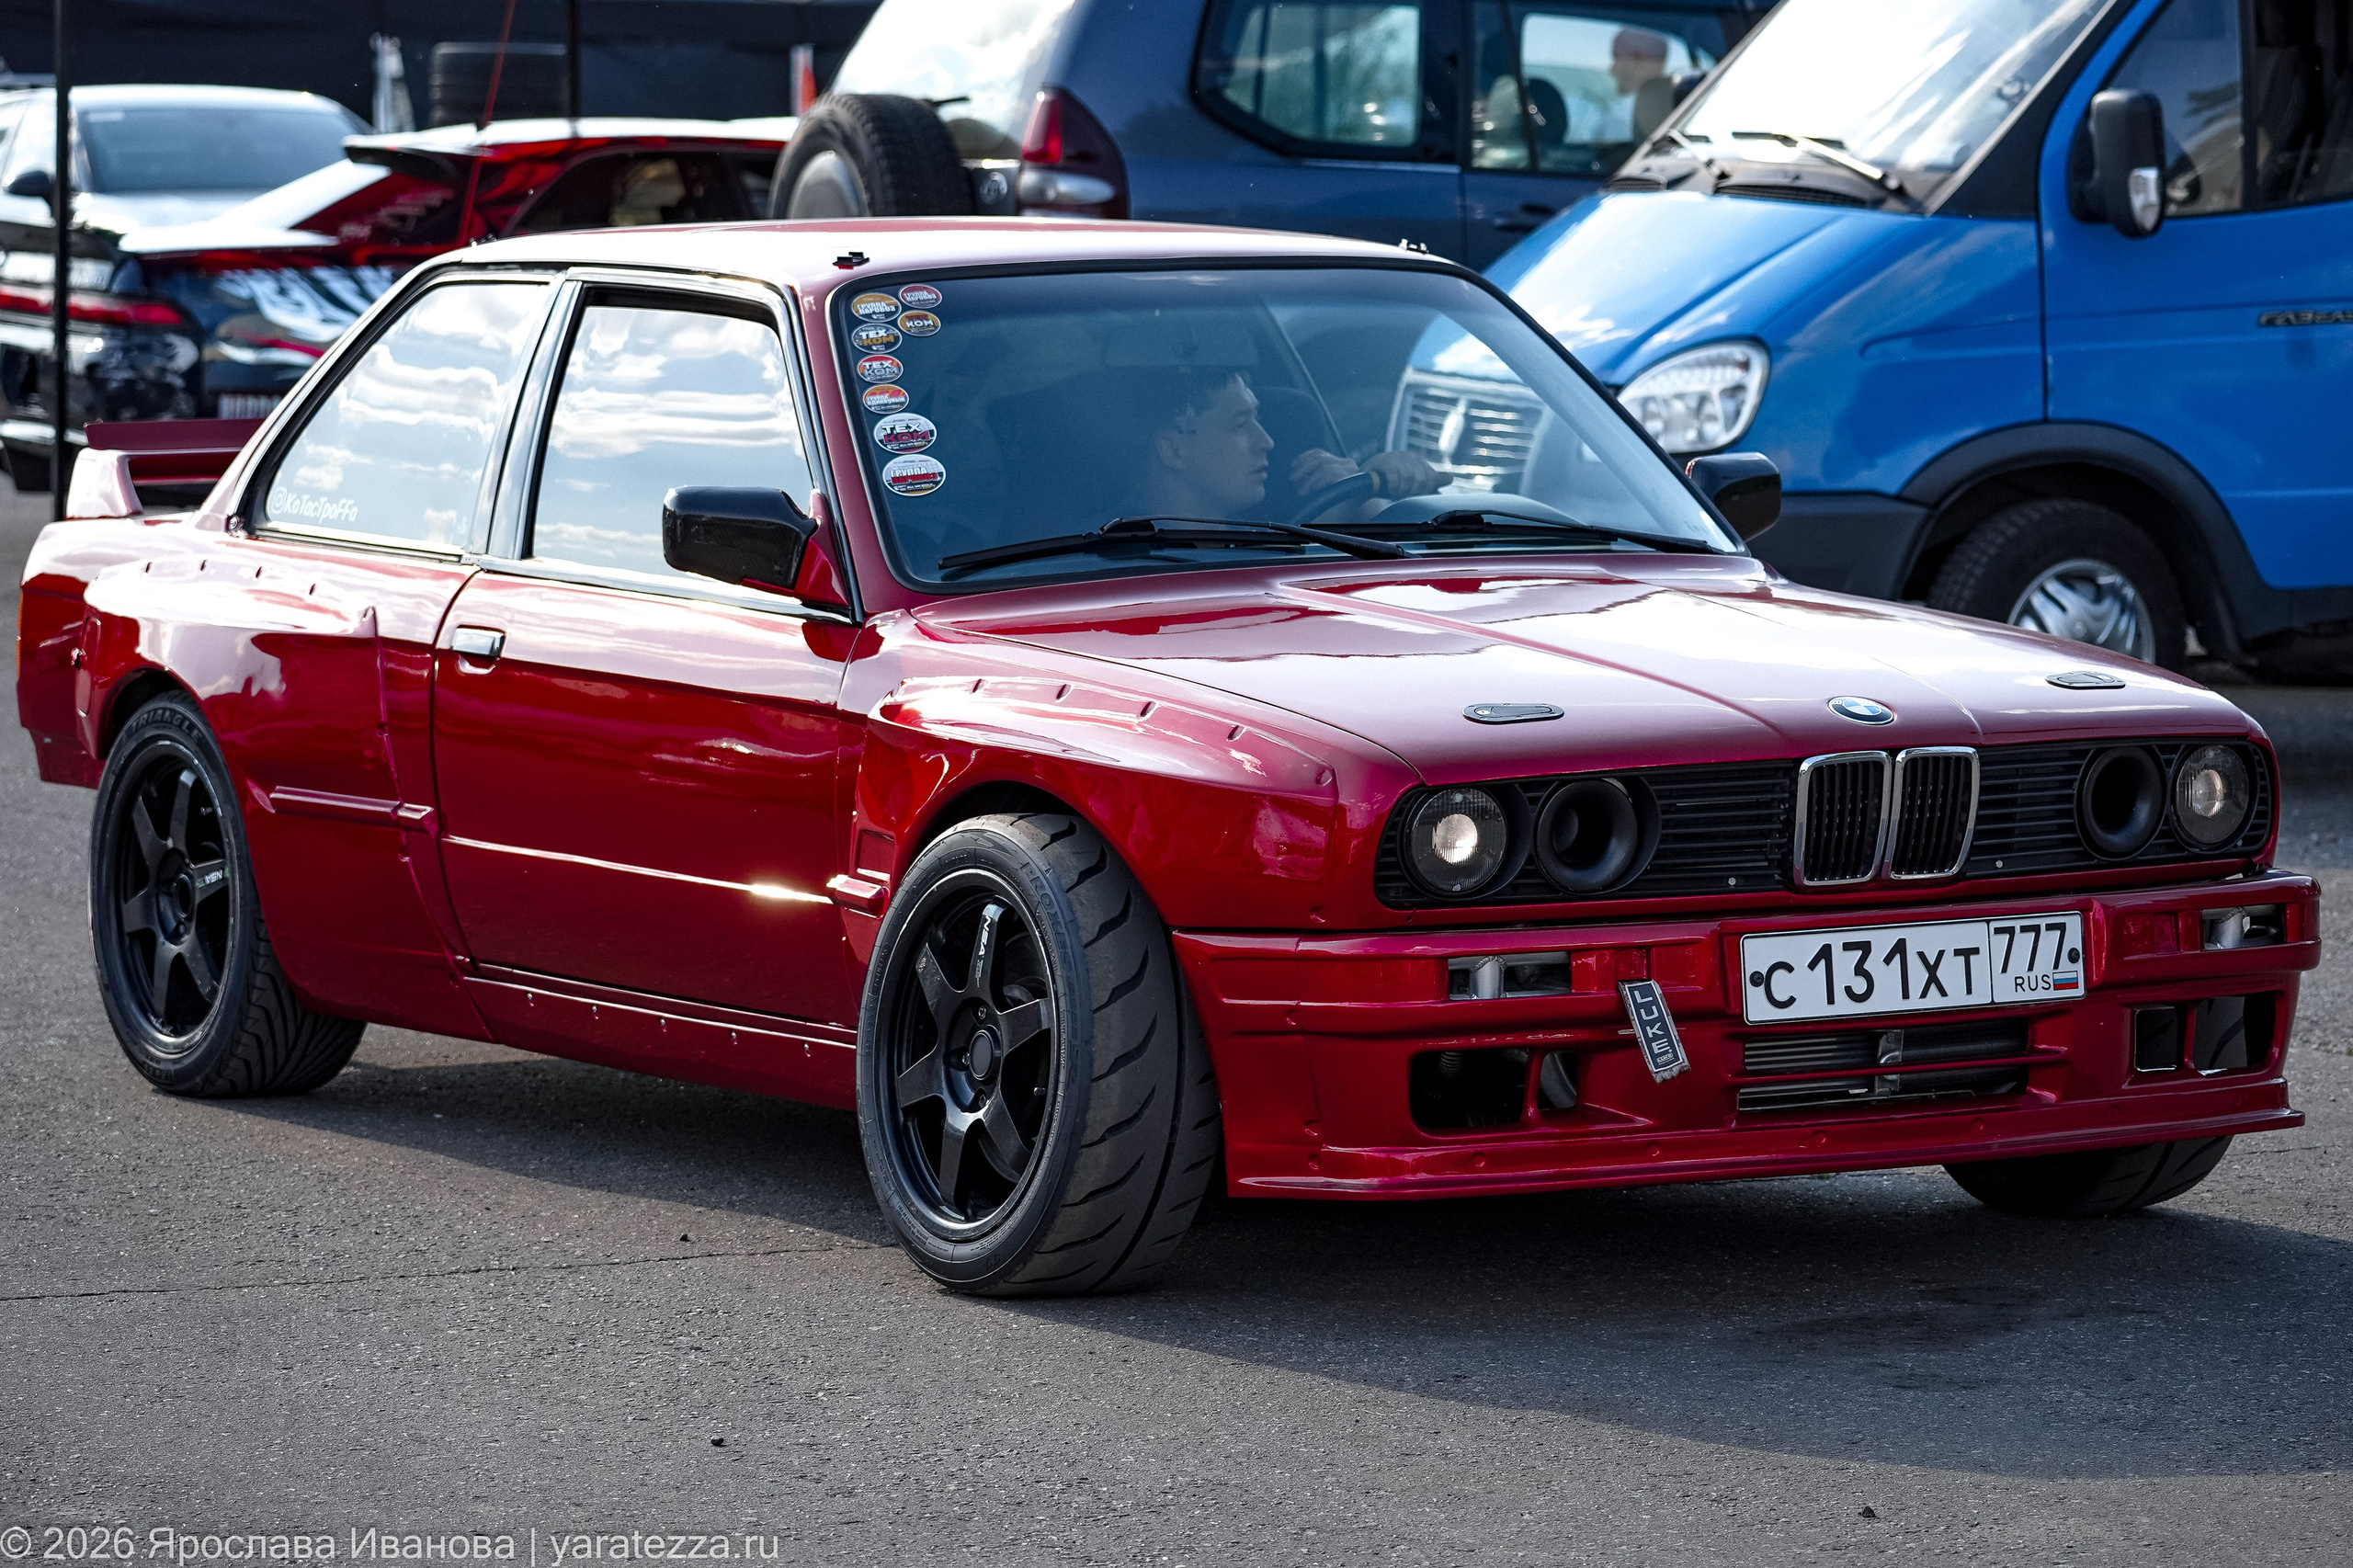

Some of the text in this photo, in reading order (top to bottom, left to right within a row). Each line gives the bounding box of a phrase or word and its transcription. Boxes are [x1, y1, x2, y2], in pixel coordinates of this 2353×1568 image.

[857, 301, 887, 311] ГРУППА
[858, 306, 896, 315] ПАРОВОЗ
[905, 319, 935, 328] КОМ
[859, 329, 888, 340] ТЕХ
[863, 334, 895, 347] КОМ
[862, 359, 892, 369] ТЕХ
[864, 367, 898, 376] КОМ
[881, 423, 923, 435] ТЕХ
[883, 430, 930, 444] КОМ
[890, 467, 928, 478] ГРУППА
[1993, 922, 2066, 974] 777
[2014, 973, 2052, 994] RUS
[1633, 990, 1671, 1054] LUKE
